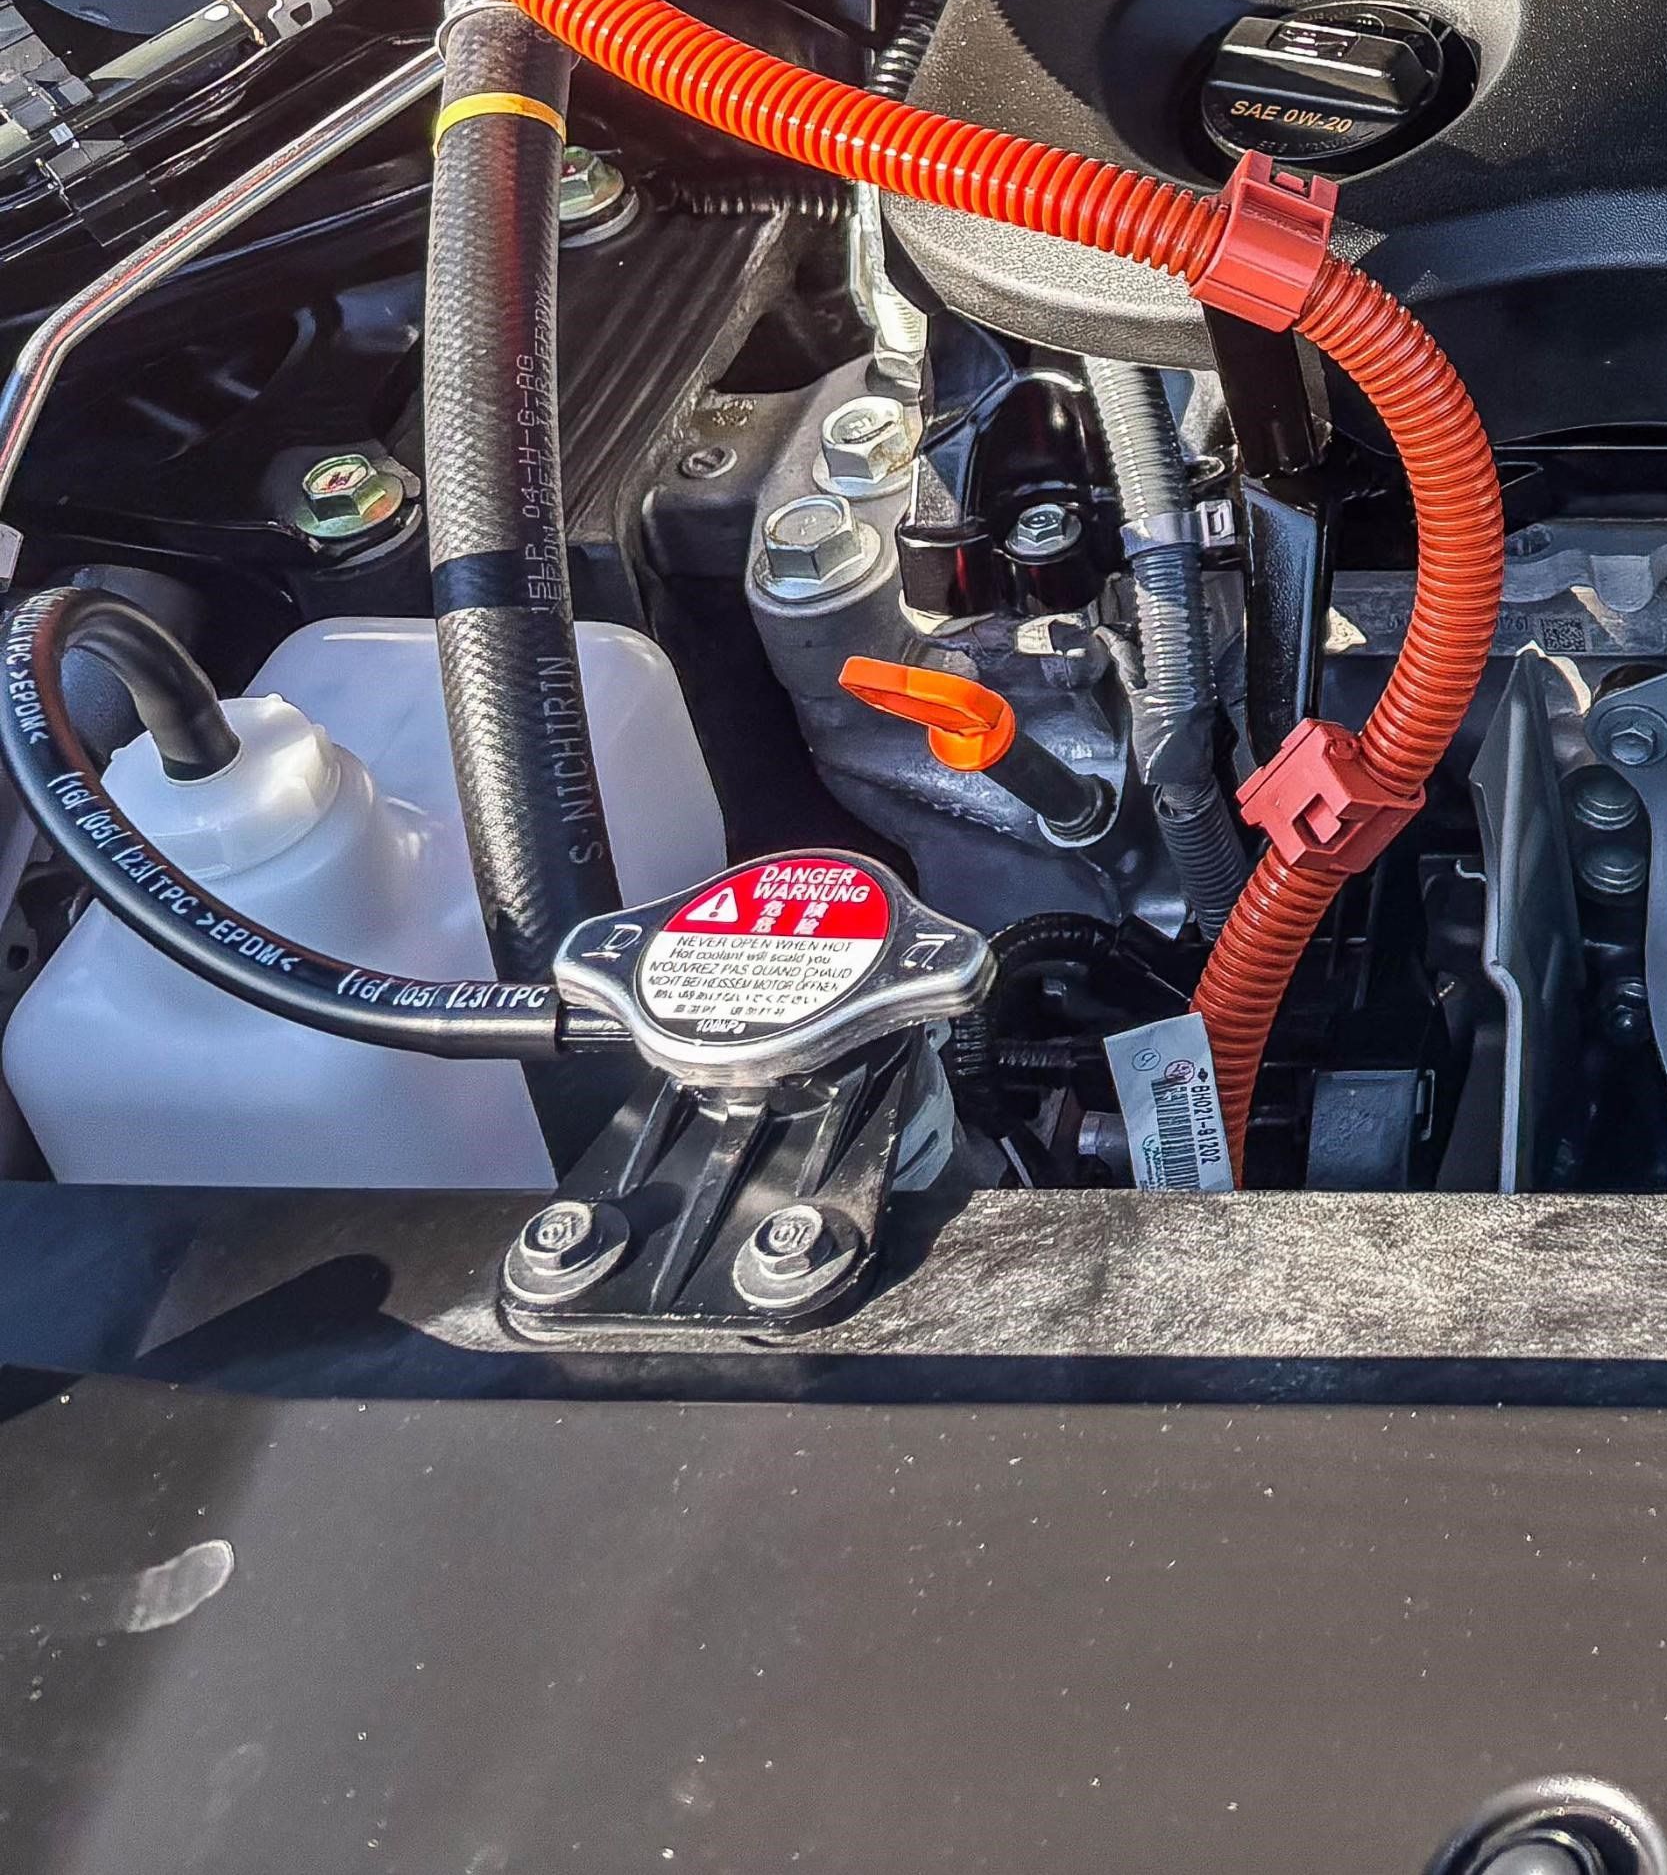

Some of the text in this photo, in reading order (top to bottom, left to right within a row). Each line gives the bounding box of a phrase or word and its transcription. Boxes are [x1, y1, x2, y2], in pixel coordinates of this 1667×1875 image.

[1230, 100, 1281, 122] SAE
[1283, 108, 1354, 134] 0W-20
[759, 865, 857, 886] DANGER
[753, 880, 871, 903] WARNUNG
[668, 946, 693, 959] Hot
[695, 948, 745, 961] coolant
[675, 935, 855, 953] NEVER OPEN WHEN HOT
[719, 962, 750, 976] PAS
[751, 963, 800, 978] QUAND
